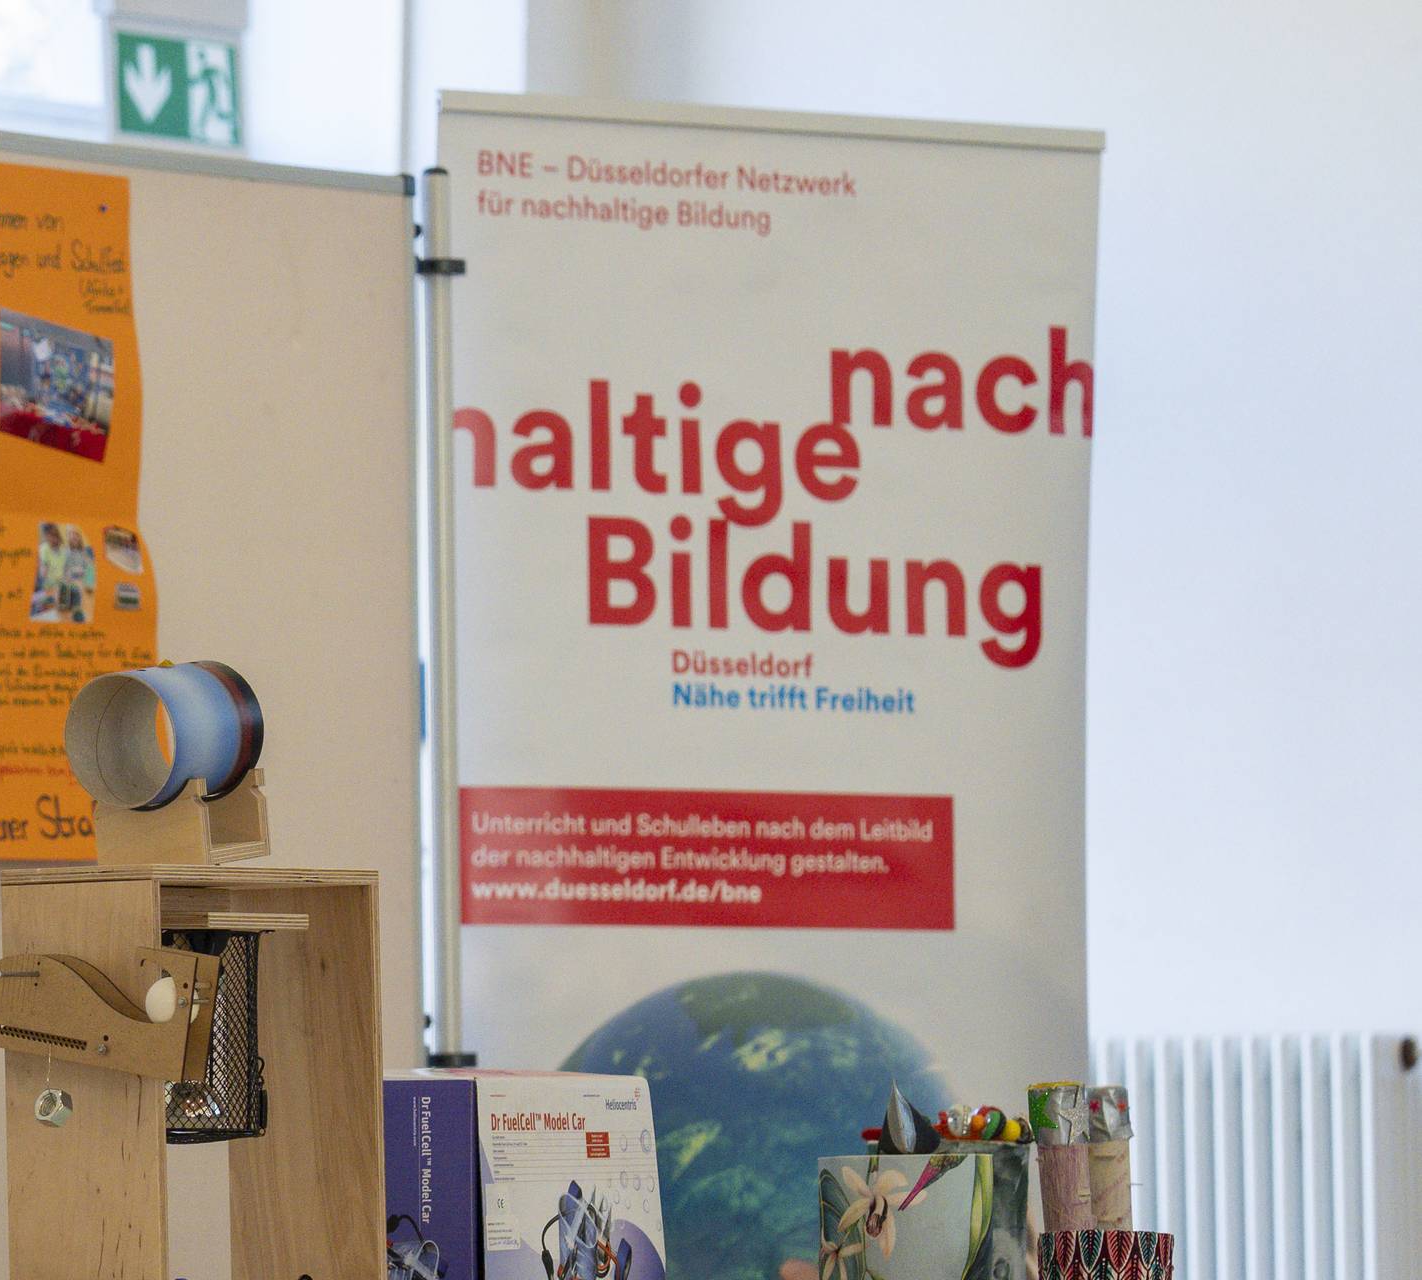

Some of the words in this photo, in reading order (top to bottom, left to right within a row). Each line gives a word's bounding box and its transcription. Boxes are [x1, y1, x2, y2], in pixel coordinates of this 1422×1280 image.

[478, 149, 534, 179] BNE
[566, 155, 730, 191] Düsseldorfer
[736, 164, 858, 198] Netzwerk
[478, 188, 512, 217] für
[521, 194, 669, 231] nachhaltige
[676, 198, 773, 238] Bildung
[830, 326, 1095, 438] nach
[586, 513, 1044, 669] Bildung
[671, 649, 815, 678] Düsseldorf
[672, 681, 742, 709] Nähe
[748, 685, 808, 712] trifft
[815, 687, 916, 714] Freiheit
[471, 810, 587, 836] Unterricht
[591, 812, 633, 836] und
[637, 812, 751, 839] Schulleben
[755, 815, 807, 840] nach
[809, 816, 857, 841] dem
[859, 817, 935, 843] Leitbild
[471, 844, 510, 868] der
[515, 844, 657, 874] nachhaltigen
[660, 845, 787, 877] Entwicklung
[790, 850, 891, 878] gestalten.
[471, 876, 763, 904] www.duesseldorf.de/bne
[421, 1096, 432, 1110] Dr
[605, 1098, 638, 1112] Heliocentris
[491, 1113, 501, 1131] Dr
[544, 1113, 570, 1131] Model
[572, 1113, 586, 1131] Car
[421, 1168, 432, 1203] Model
[421, 1204, 432, 1224] Car
